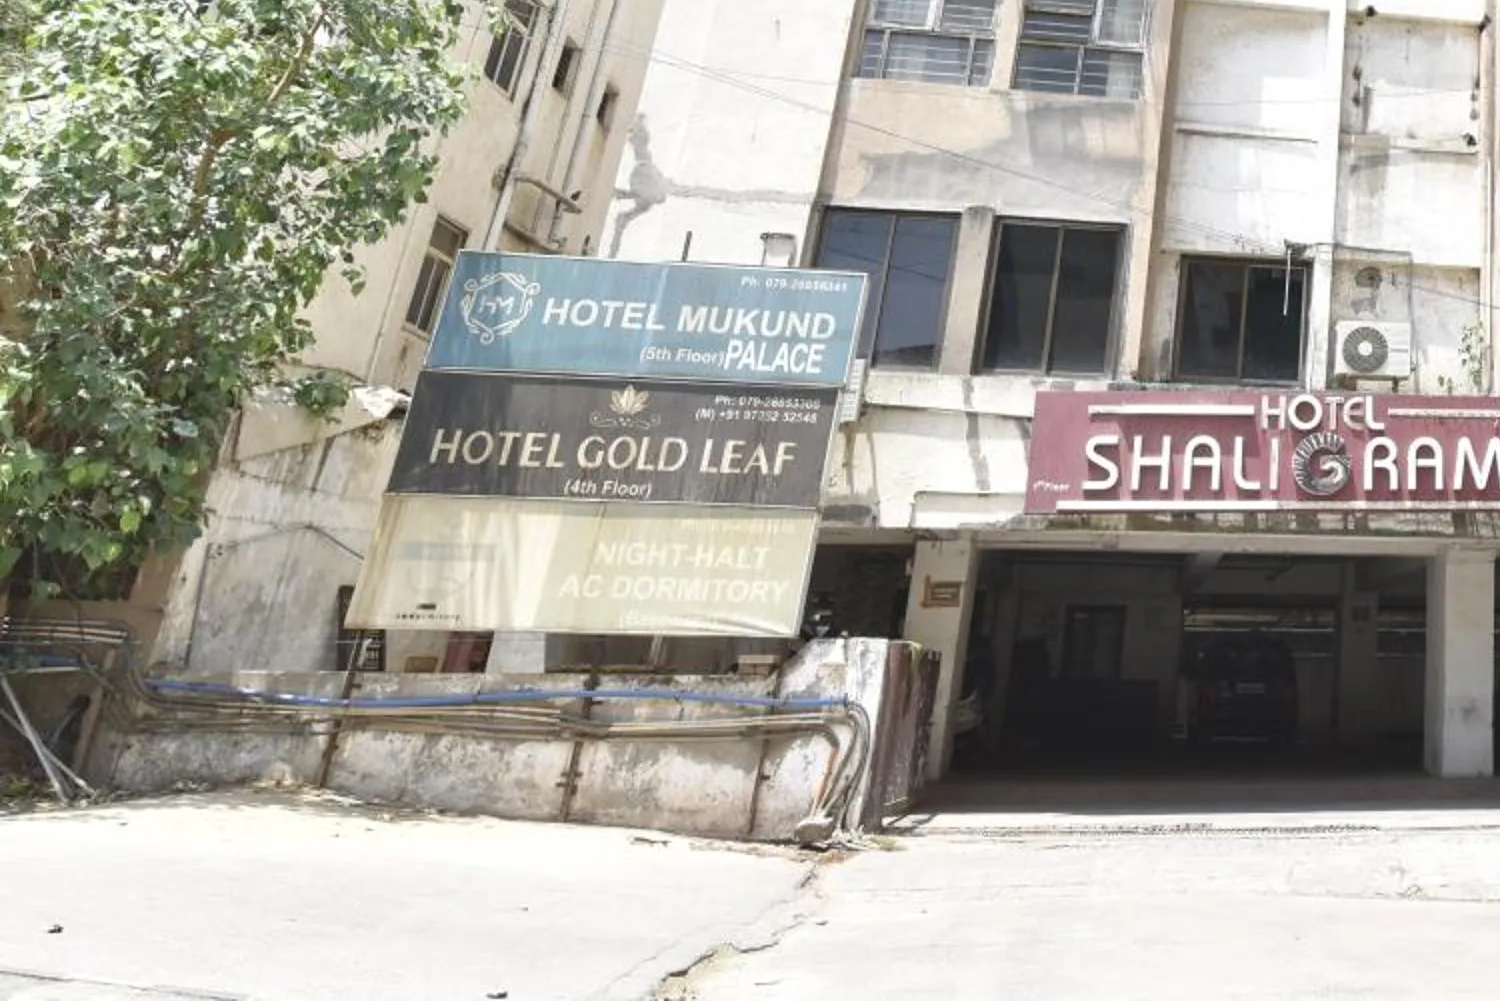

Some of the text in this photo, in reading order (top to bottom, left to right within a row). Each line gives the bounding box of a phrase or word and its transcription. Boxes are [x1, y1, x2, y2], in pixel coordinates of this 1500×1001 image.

[541, 297, 837, 340] HOTEL MUKUND
[640, 345, 726, 369] (5th Floor)
[724, 339, 827, 374] PALACE
[1261, 394, 1385, 431] HOTEL
[428, 429, 798, 477] HOTEL GOLD LEAF
[563, 477, 652, 498] (4th Floor)
[595, 540, 771, 570] NIGHT-HALT
[559, 574, 791, 604] AC DORMITORY
